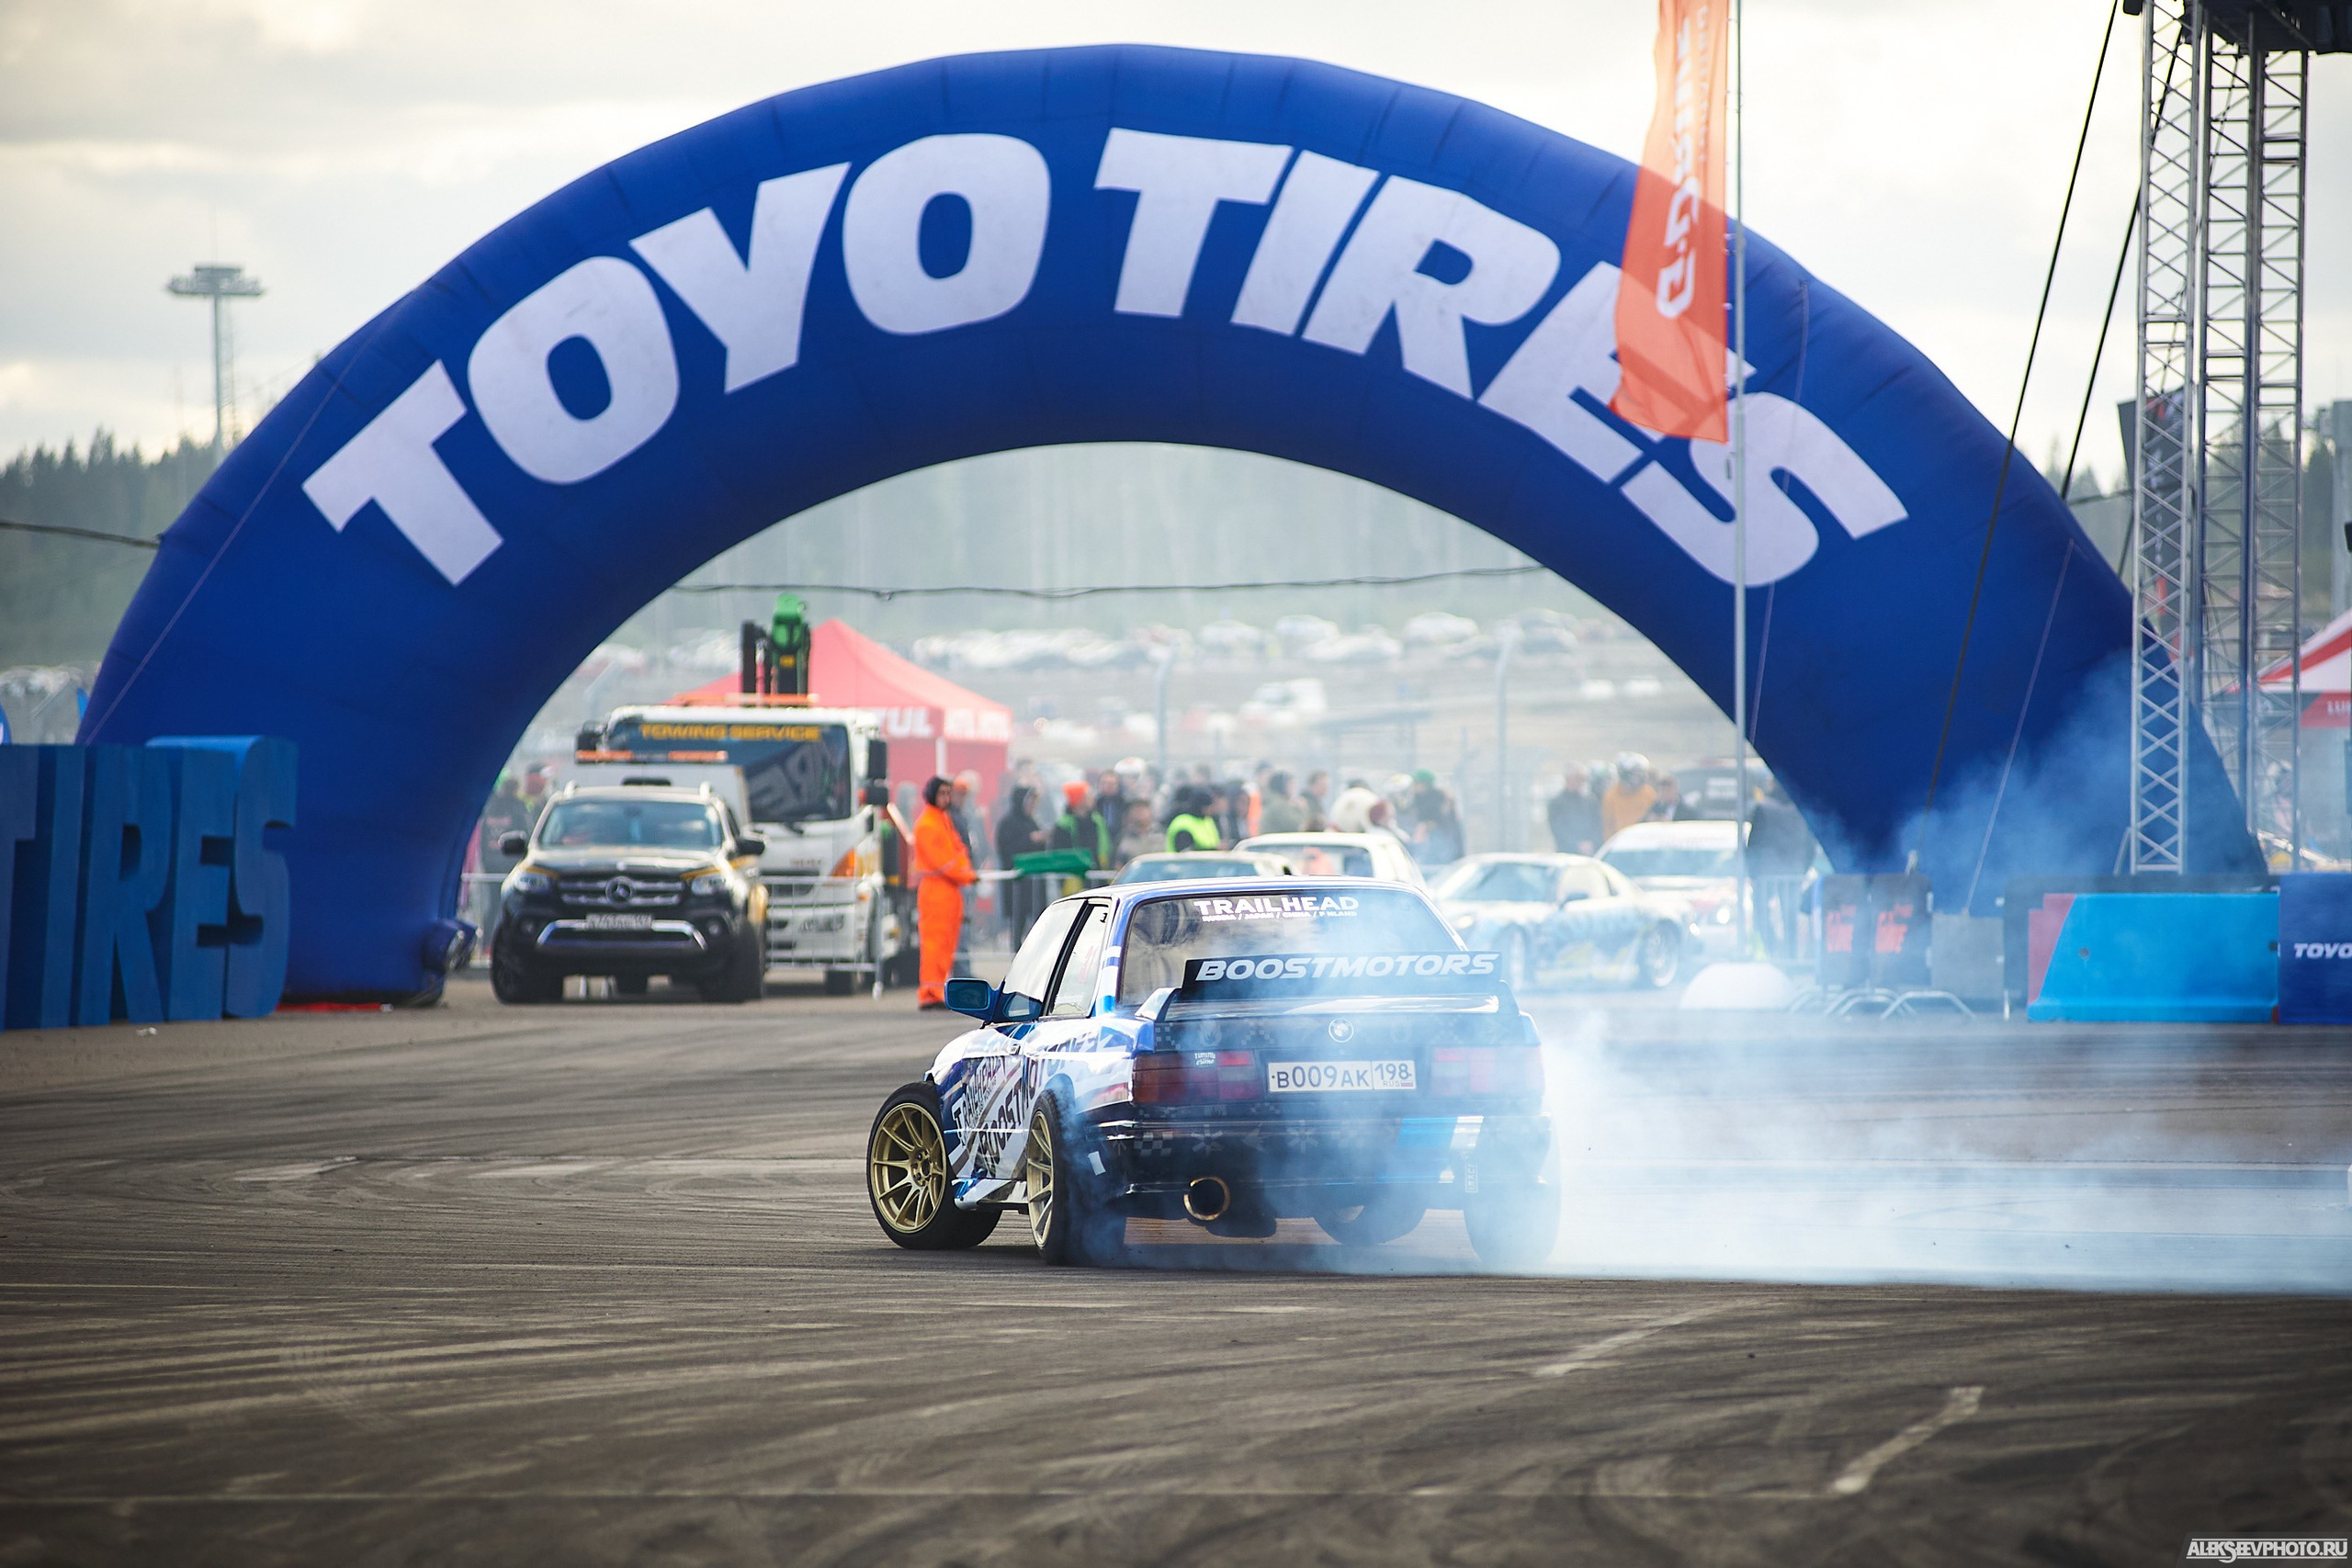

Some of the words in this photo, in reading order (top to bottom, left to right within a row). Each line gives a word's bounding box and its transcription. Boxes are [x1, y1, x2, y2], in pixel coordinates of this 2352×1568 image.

[301, 132, 1051, 586] TOYO
[1094, 128, 1909, 587] TIRES
[639, 723, 727, 739] TOWING
[729, 724, 820, 740] SERVICE
[2294, 942, 2352, 959] TOYO
[1195, 953, 1500, 981] BOOSTMOTORS
[1374, 1064, 1409, 1080] 198
